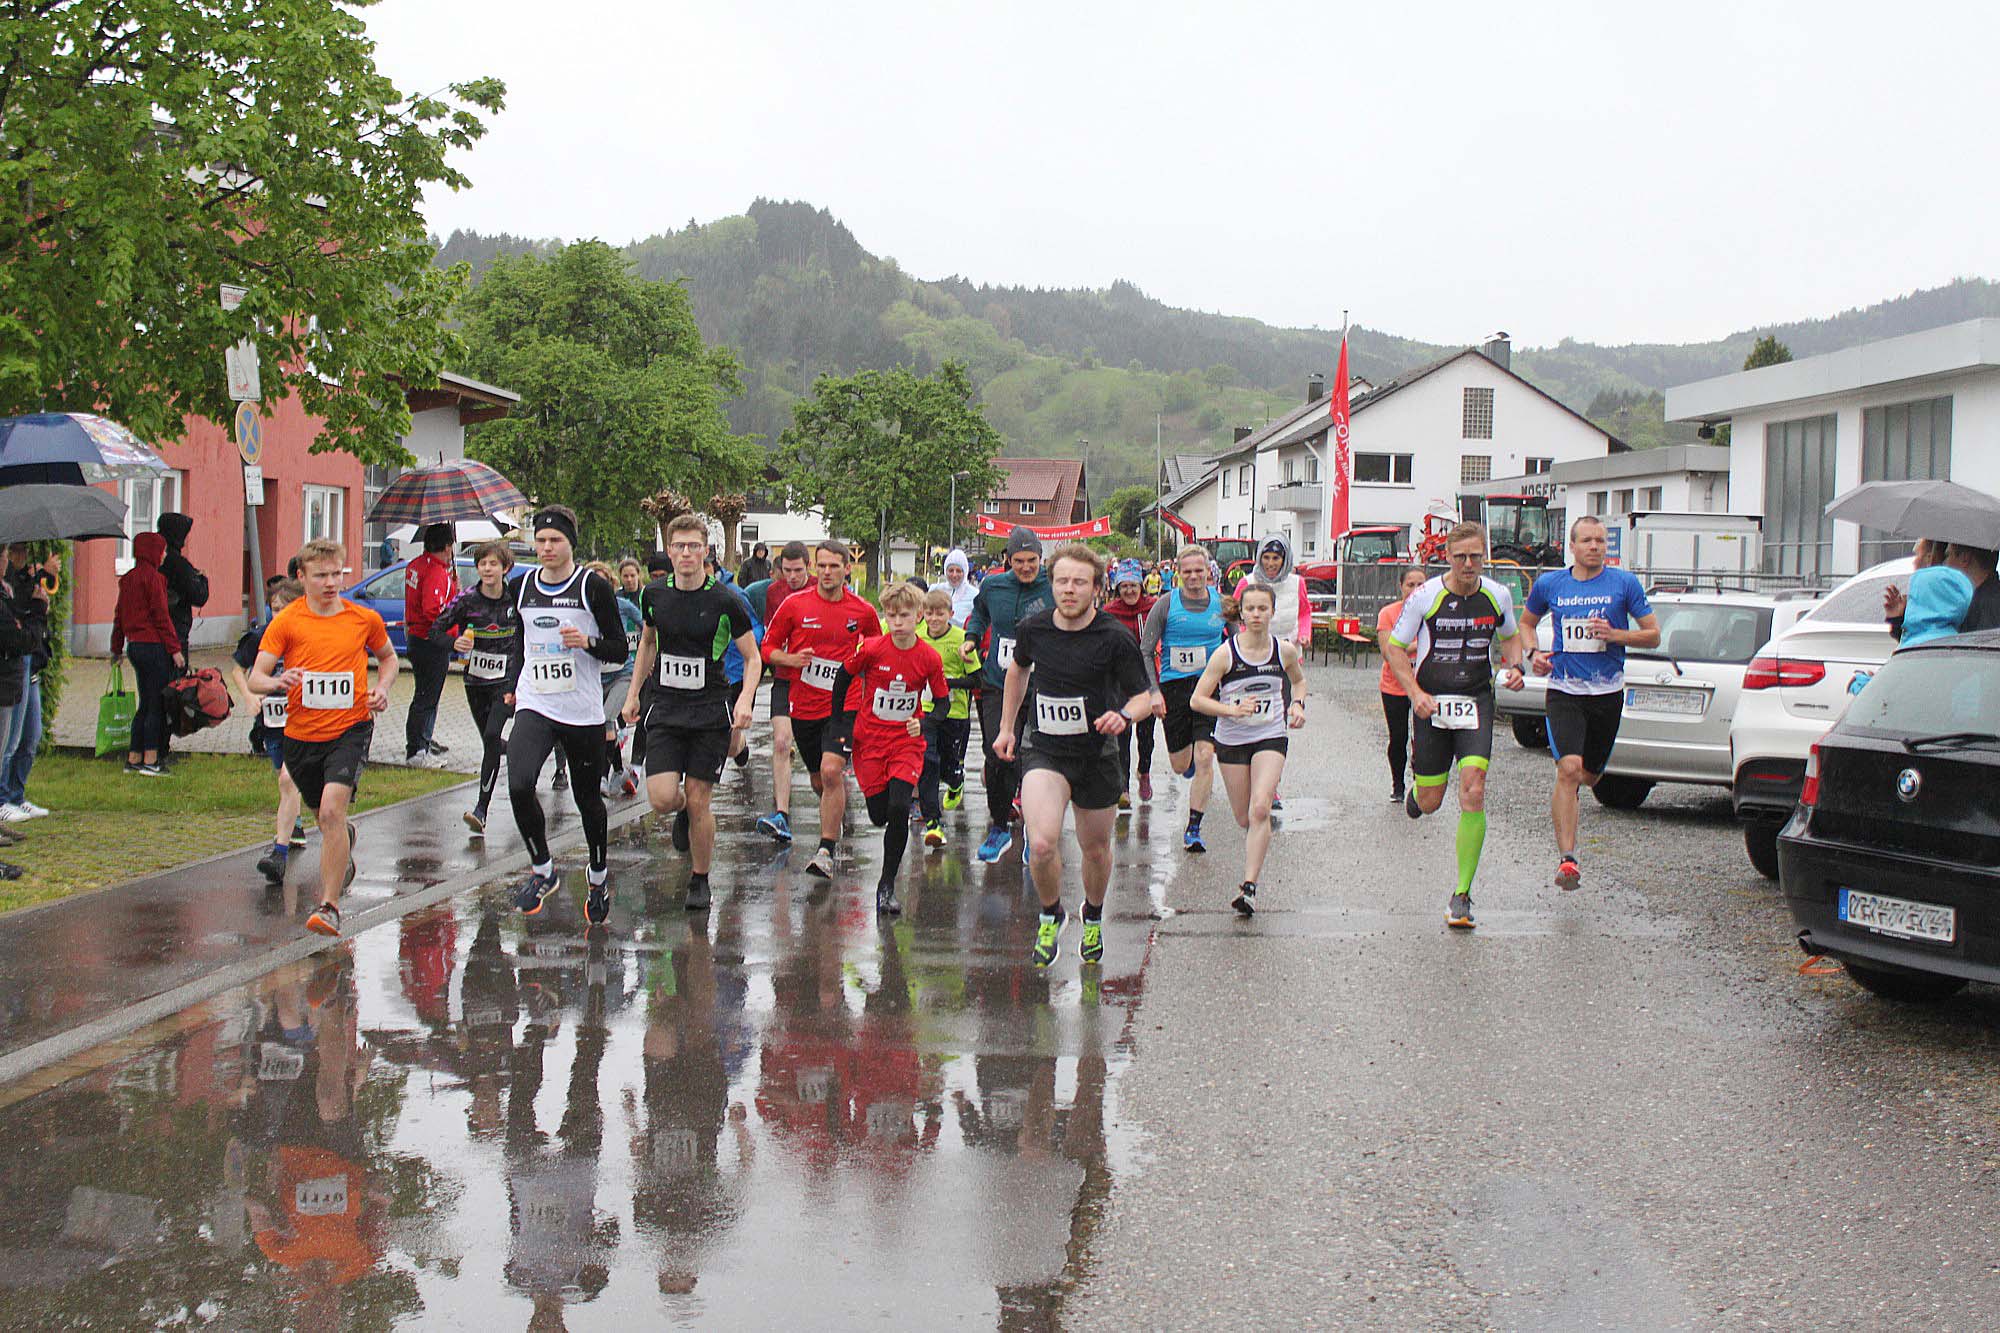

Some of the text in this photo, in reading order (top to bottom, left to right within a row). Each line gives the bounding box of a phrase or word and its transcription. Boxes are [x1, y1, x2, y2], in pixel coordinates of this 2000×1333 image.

[1557, 595, 1612, 607] badenova
[474, 656, 503, 671] 1064
[1179, 652, 1194, 663] 31
[533, 662, 573, 680] 1156
[664, 661, 700, 678] 1191
[806, 661, 838, 680] 1185
[306, 679, 350, 696] 1110
[878, 696, 915, 711] 1123
[1437, 702, 1474, 717] 1152
[1040, 703, 1082, 722] 1109
